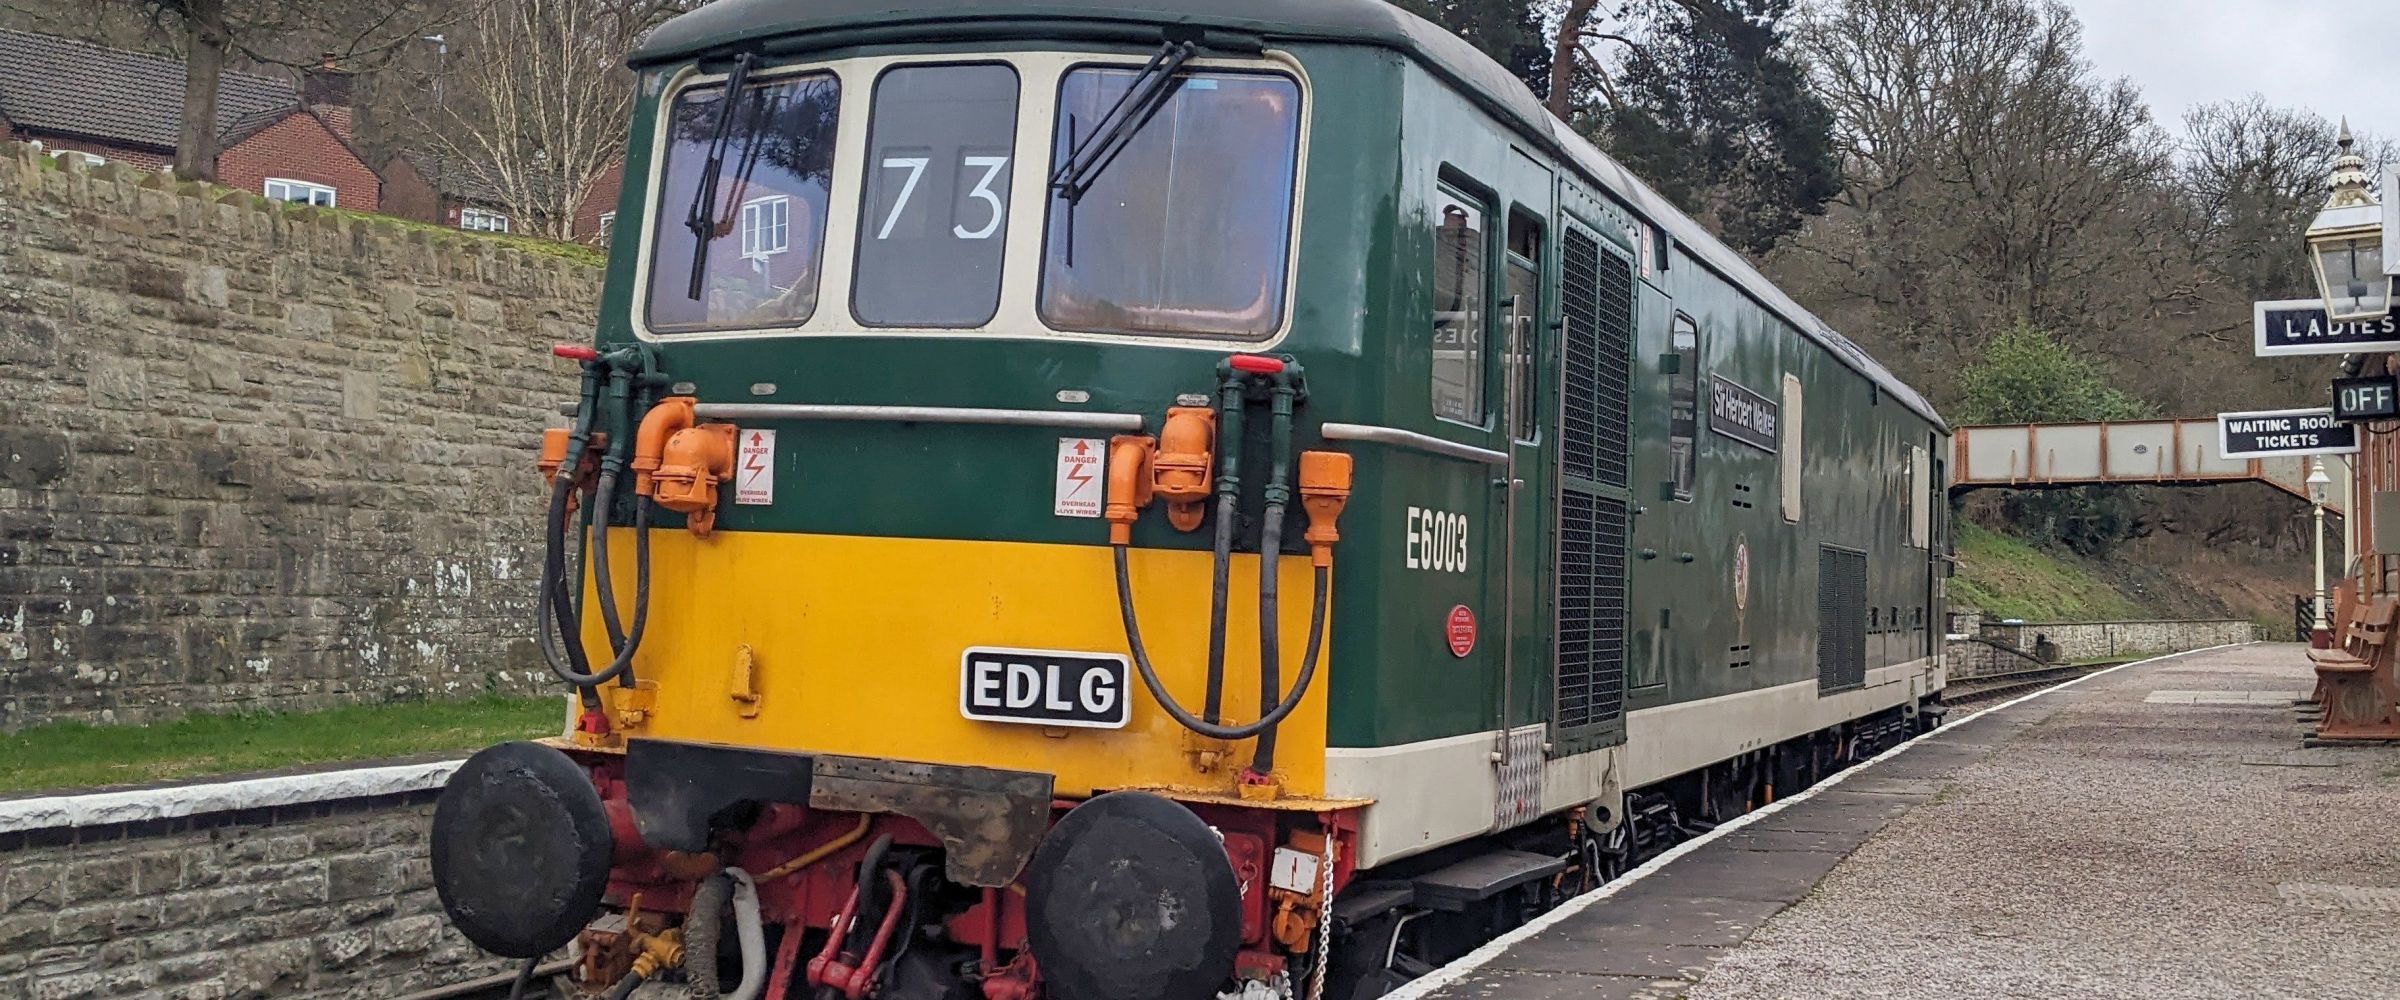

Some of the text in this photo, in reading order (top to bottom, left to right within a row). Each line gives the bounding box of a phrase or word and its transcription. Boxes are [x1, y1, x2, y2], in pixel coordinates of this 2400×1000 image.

[2286, 315, 2396, 338] LADIES
[2341, 386, 2392, 412] OFF
[1714, 382, 1775, 438] Sir Herbert Walker
[2229, 418, 2291, 434] WAITING
[2256, 433, 2320, 449] TICKETS
[1064, 455, 1097, 464] DANGER
[1061, 500, 1096, 508] OVERHEAD
[1076, 508, 1098, 516] WIRES
[1406, 506, 1467, 573] E6003
[974, 661, 1116, 713] EDLG
